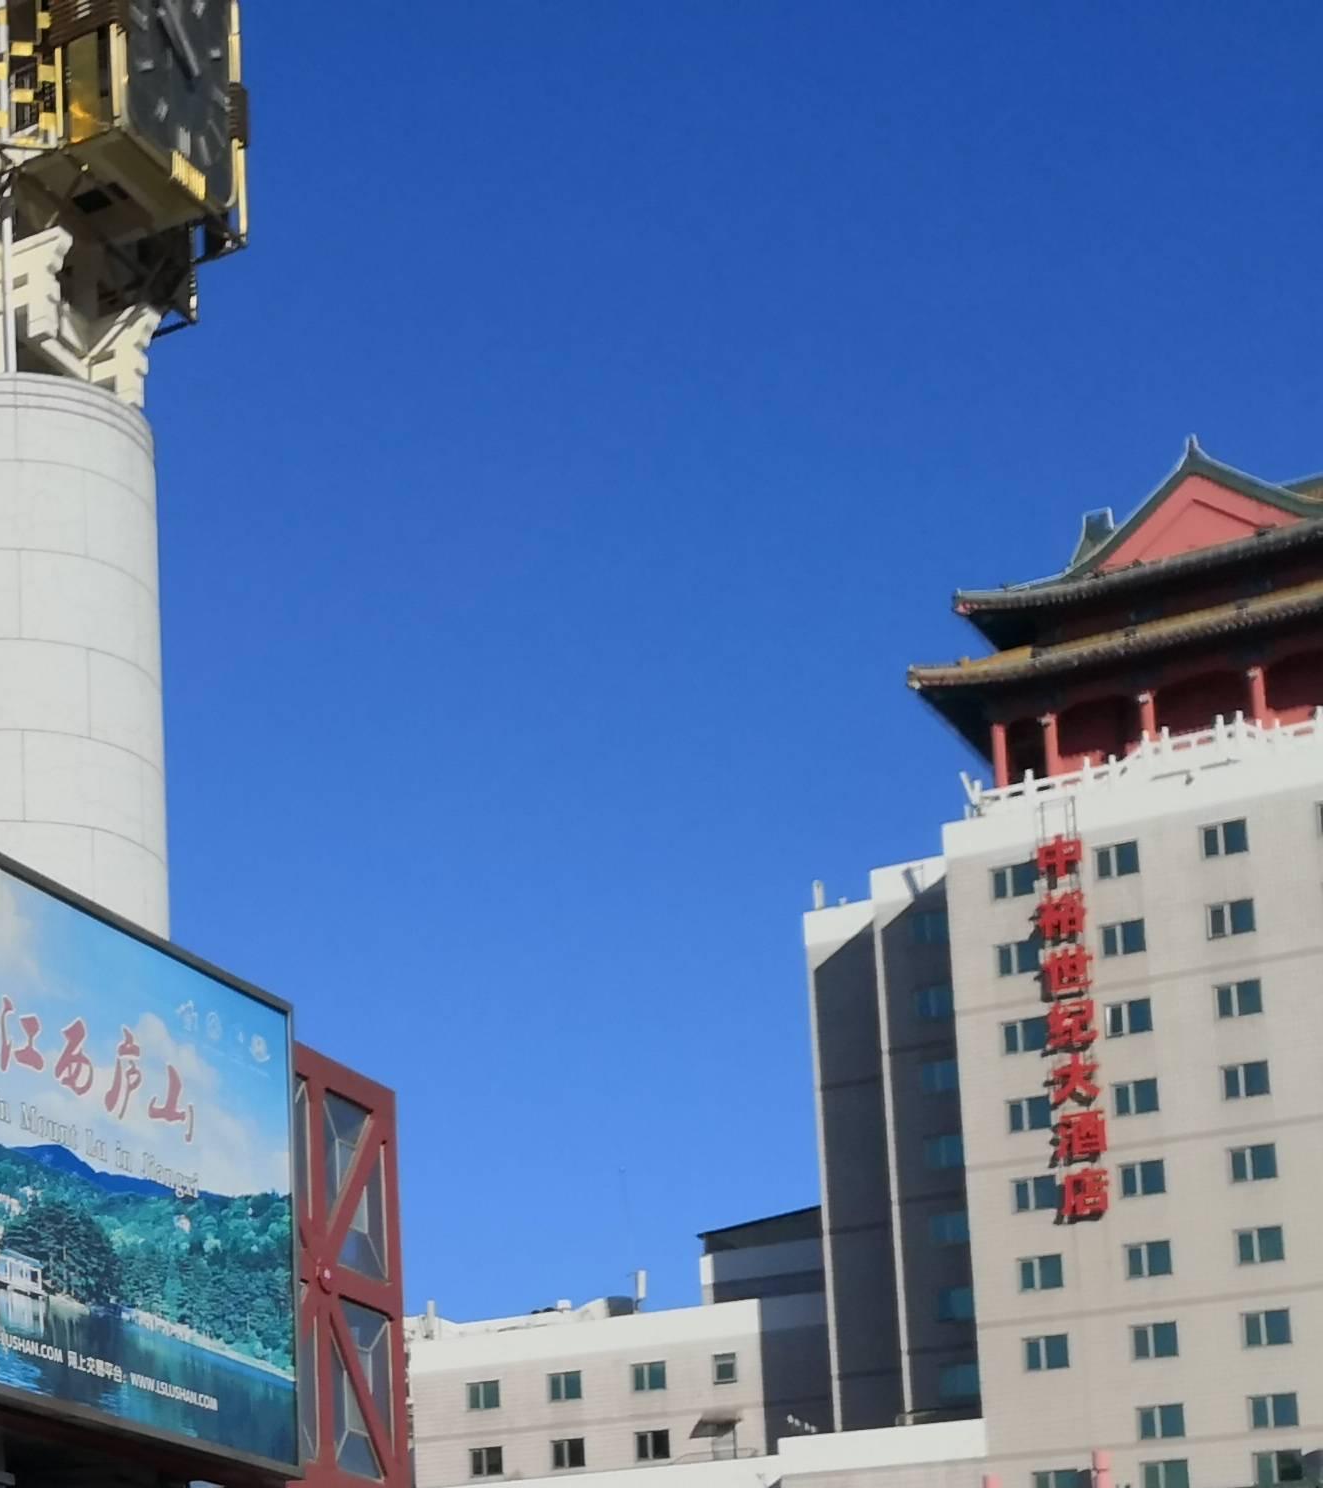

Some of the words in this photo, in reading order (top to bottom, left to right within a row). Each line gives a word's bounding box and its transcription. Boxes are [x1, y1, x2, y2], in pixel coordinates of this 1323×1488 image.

[0, 996, 195, 1144] 江西庐山
[1037, 834, 1109, 1218] 中裕世纪大酒店
[20, 1102, 78, 1150] Mount
[85, 1128, 108, 1162] Lu
[115, 1139, 133, 1172] in
[142, 1151, 200, 1200] Jiangxi
